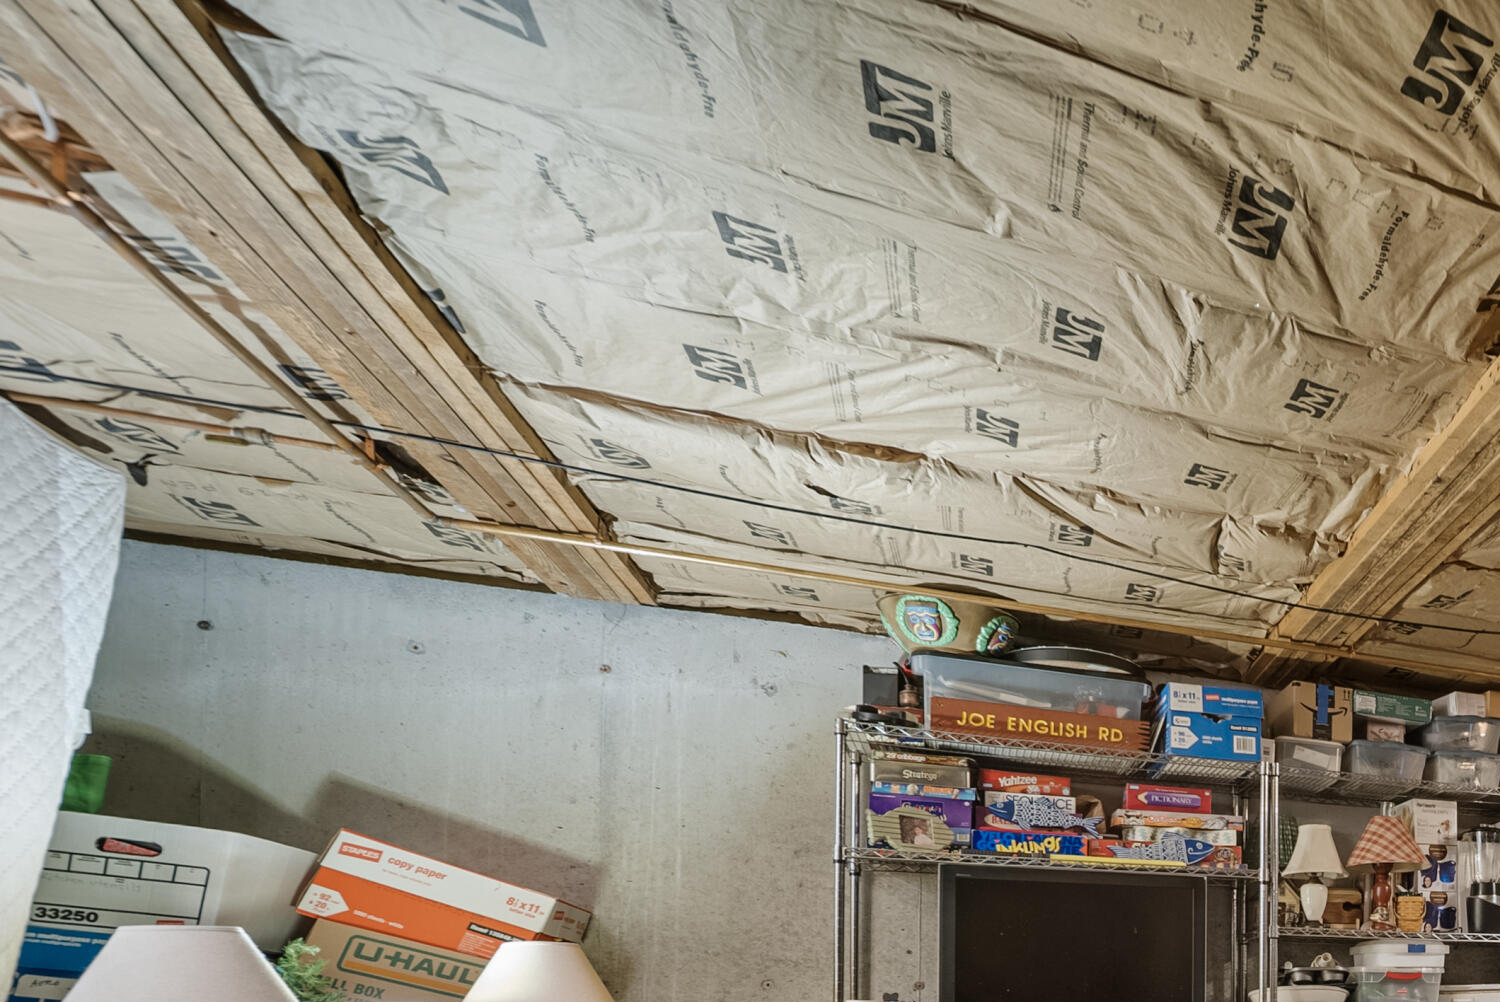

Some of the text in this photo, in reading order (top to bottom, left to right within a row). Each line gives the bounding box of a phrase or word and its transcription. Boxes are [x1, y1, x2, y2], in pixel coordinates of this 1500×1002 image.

[1400, 9, 1494, 117] JM
[860, 59, 937, 154] JM
[1214, 163, 1241, 237] Johns Manville
[1227, 174, 1296, 261] JM
[711, 209, 789, 274] JM
[1052, 306, 1106, 362] JM
[682, 343, 749, 391] JM
[1285, 377, 1340, 420] JM
[977, 407, 1020, 449] JM
[1183, 462, 1230, 491] JM
[959, 552, 995, 577] JM
[956, 710, 1124, 743] JOE ENGLISH RD
[902, 769, 938, 781] Stratego
[998, 775, 1038, 787] Yahtzee
[1005, 794, 1073, 811] SEQCE
[1151, 794, 1193, 805] PICTIONARY
[341, 843, 381, 860] STAPLES
[387, 855, 448, 883] copy paper
[34, 906, 99, 924] 33250
[529, 902, 541, 914] 11
[353, 941, 479, 987] U-HAUL
[353, 982, 385, 1001] BOX
